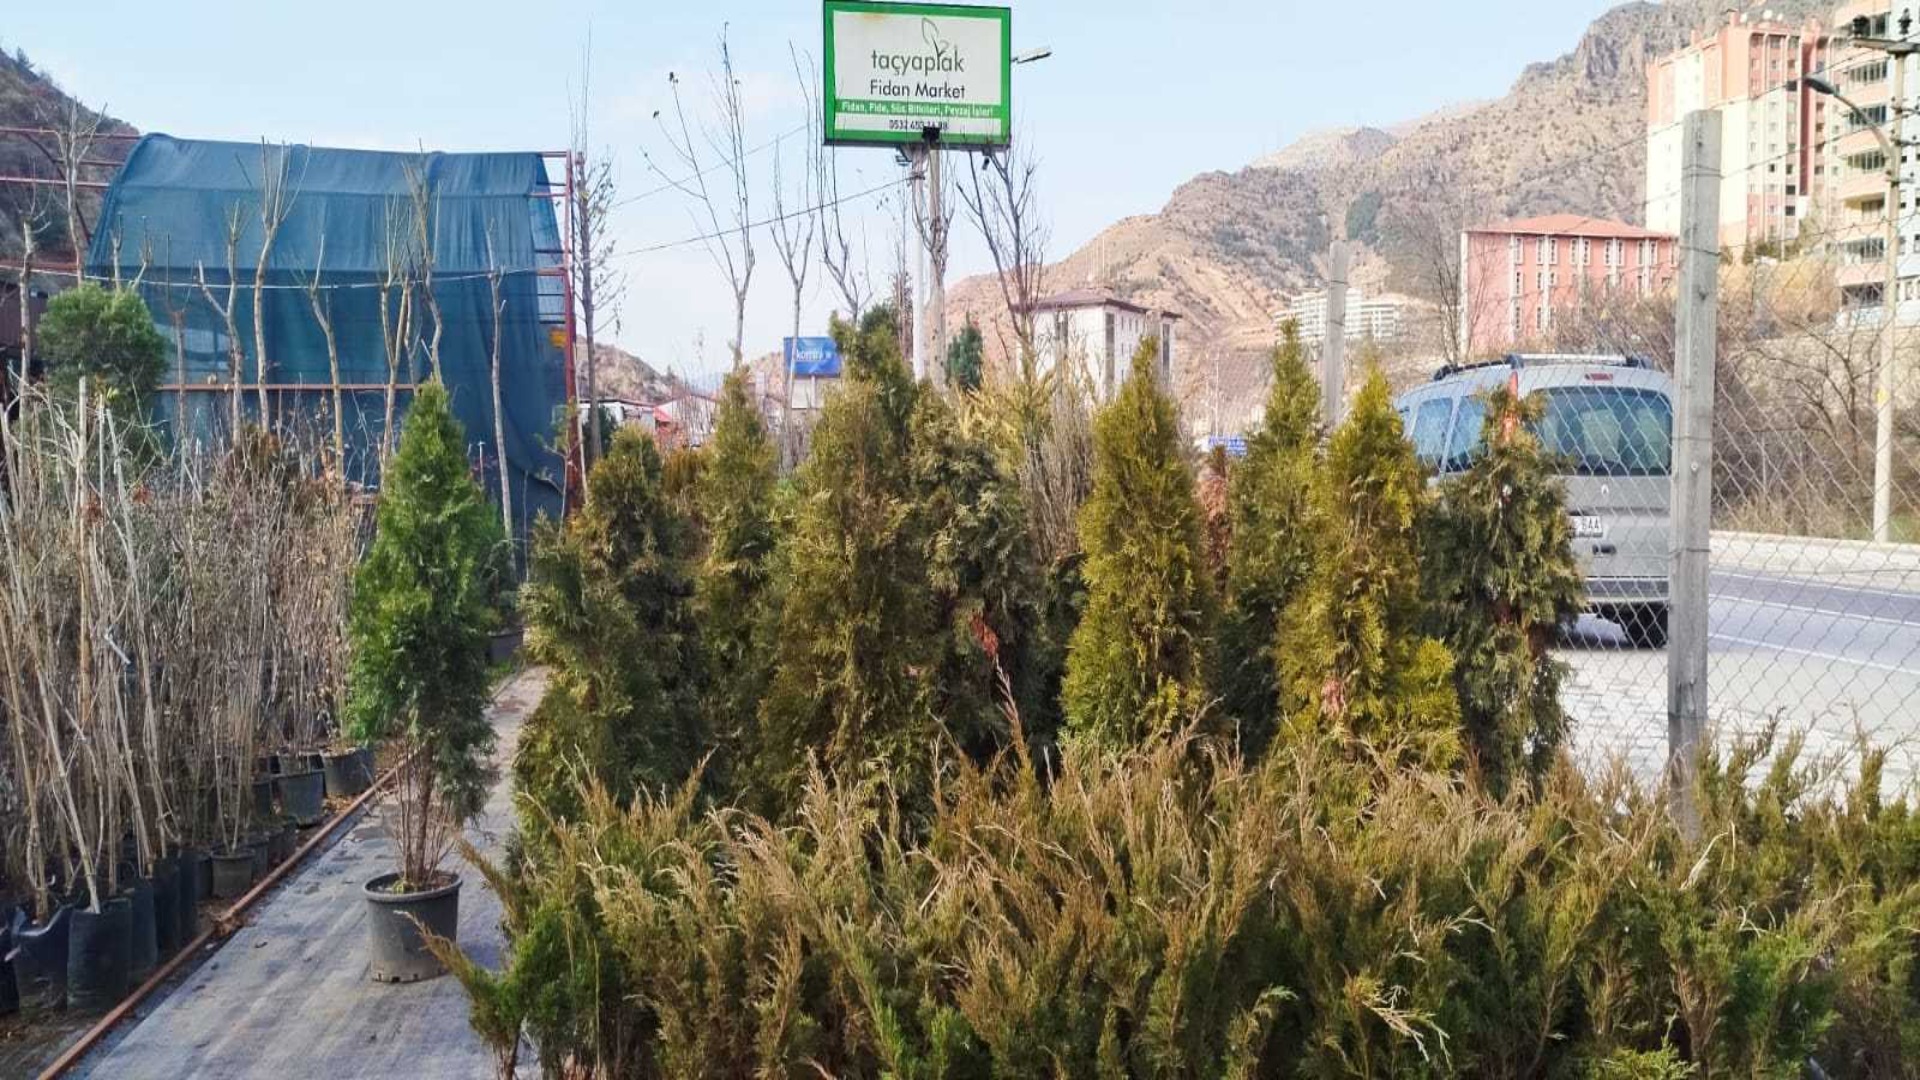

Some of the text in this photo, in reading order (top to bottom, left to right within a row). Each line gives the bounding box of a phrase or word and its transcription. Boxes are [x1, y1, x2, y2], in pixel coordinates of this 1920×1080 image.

[870, 45, 965, 76] taçyaprak
[869, 79, 965, 99] Fidan Market
